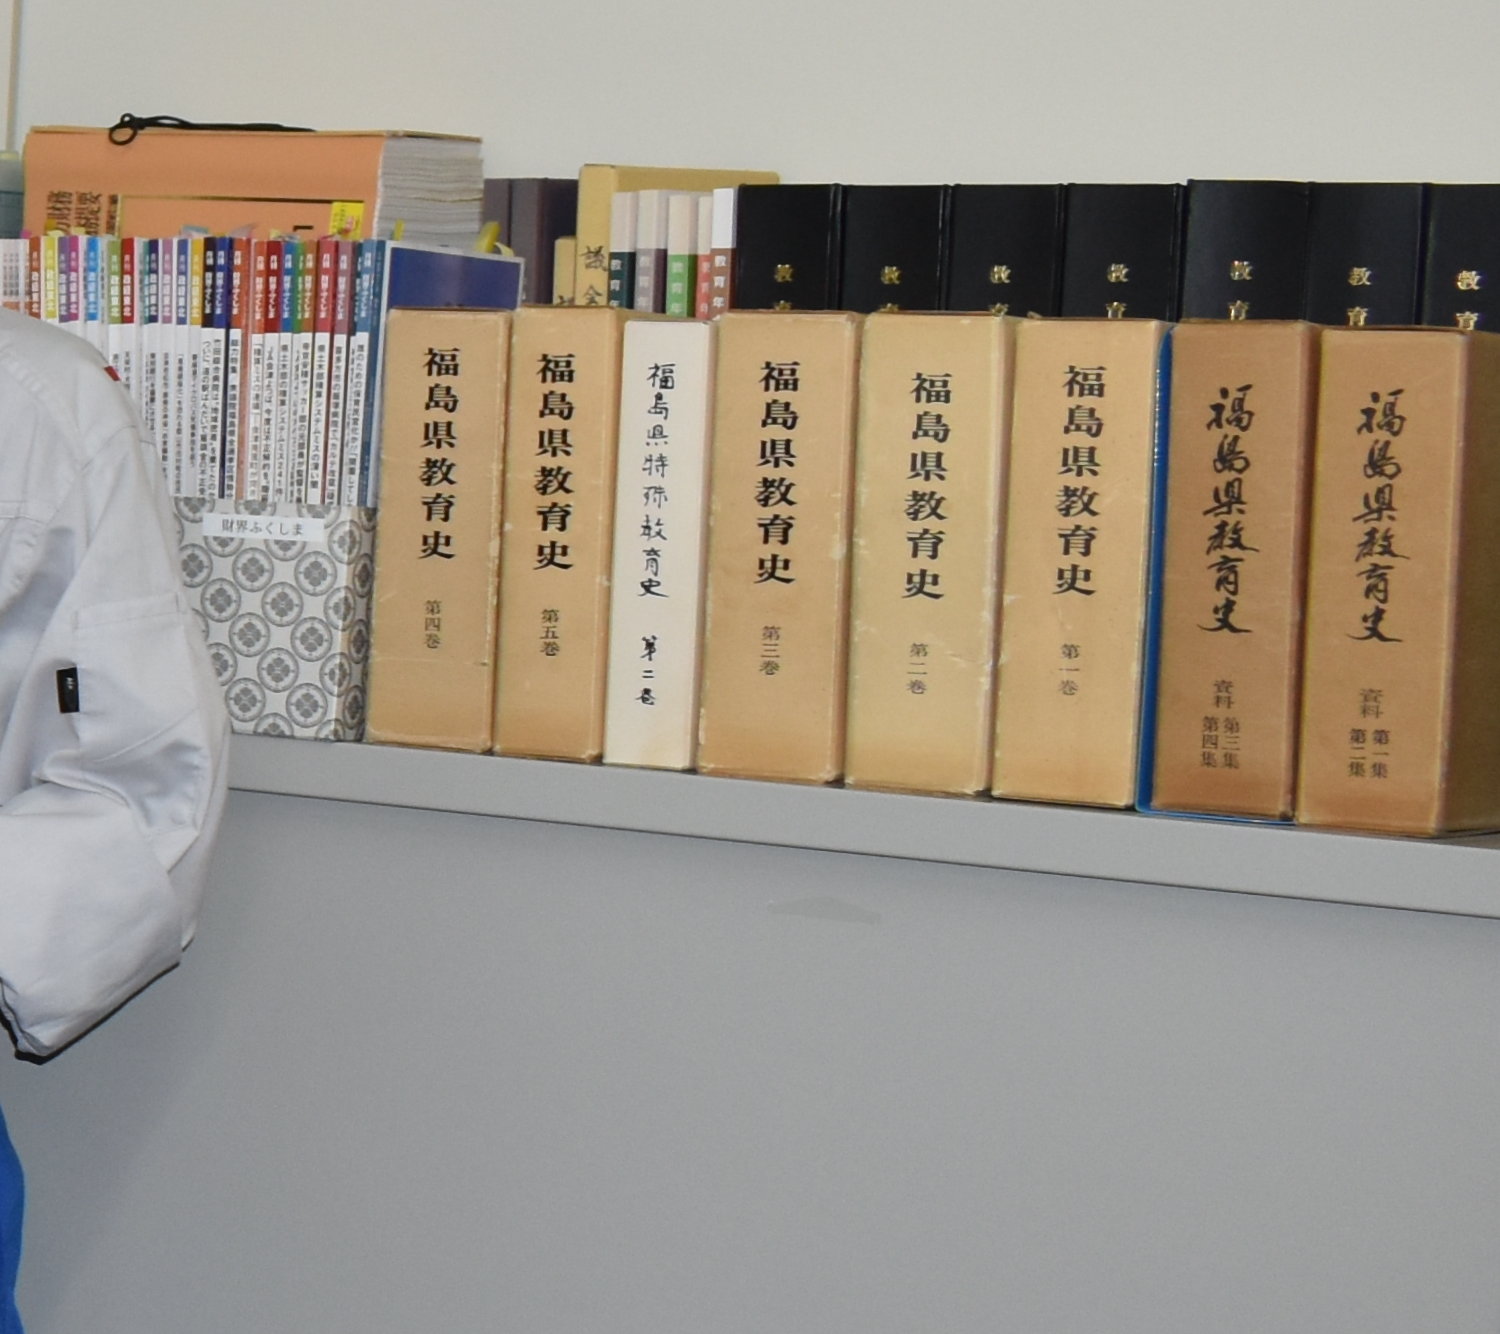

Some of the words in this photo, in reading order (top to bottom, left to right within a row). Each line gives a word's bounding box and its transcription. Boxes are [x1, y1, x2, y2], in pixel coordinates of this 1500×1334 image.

[1347, 267, 1371, 327] 教育
[1456, 270, 1482, 331] 教育
[420, 348, 460, 562] 福島県教育史
[533, 354, 576, 571] 福島県教育史
[755, 362, 800, 585] 福島県教育史
[1053, 365, 1106, 597] 福島県教育史
[903, 371, 952, 600] 福島県教育史
[1197, 384, 1259, 635] 福島県教育史
[221, 520, 304, 537] 財界ふくしま
[1346, 388, 1410, 644] 福島県教育史
[424, 600, 442, 649] 第四巻
[541, 609, 559, 656] 第五巻
[760, 625, 781, 675] 第三巻
[906, 643, 929, 695] 第二巻
[1058, 643, 1080, 696] 第一巻
[1212, 679, 1236, 710] 資料
[1359, 688, 1384, 719] 資料
[1200, 717, 1219, 768] 第四集
[1221, 717, 1240, 770] 第三集
[1347, 727, 1367, 778] 第二集
[1370, 728, 1390, 779] 第一集
